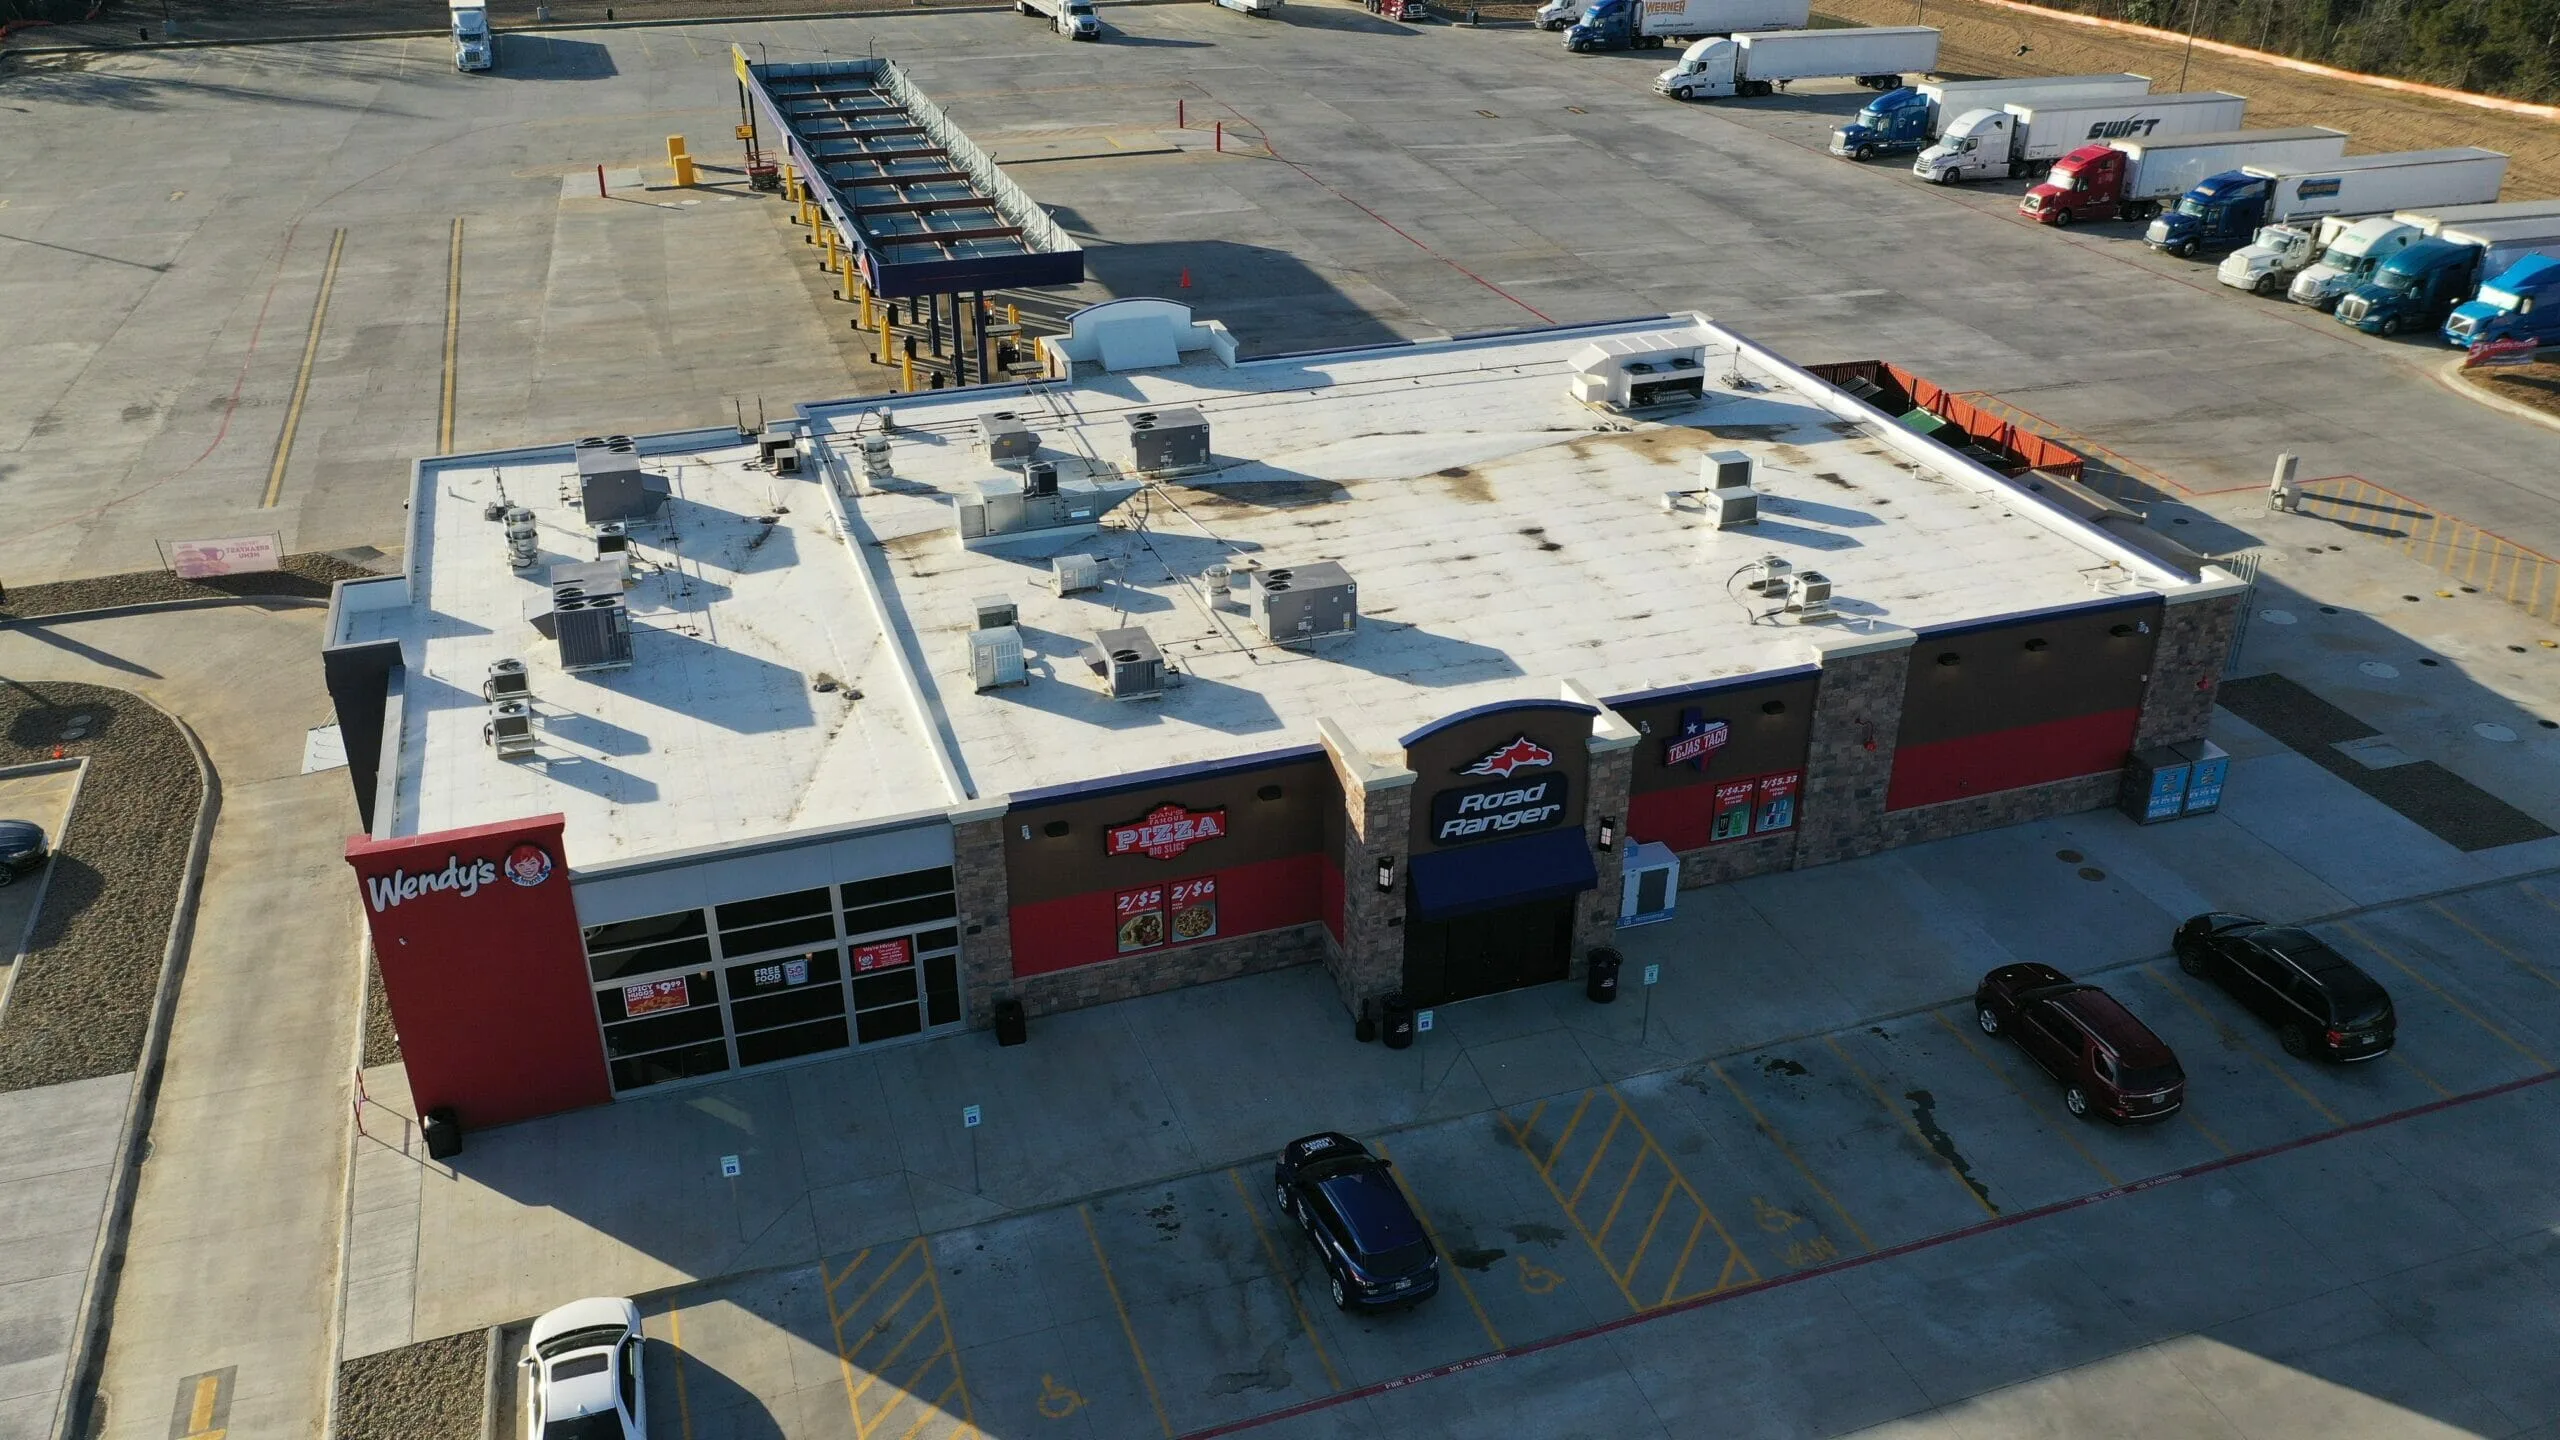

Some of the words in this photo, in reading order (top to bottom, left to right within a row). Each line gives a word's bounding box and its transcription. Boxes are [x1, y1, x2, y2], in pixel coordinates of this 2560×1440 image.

[1645, 0, 1686, 13] WERNER
[2086, 113, 2161, 140] SWIFT
[1669, 738, 1701, 761] TEJAS
[1703, 728, 1728, 748] TACO
[1458, 782, 1547, 814] Road
[1149, 809, 1184, 820] DAN'S
[1149, 815, 1184, 825] FAMOUS
[1440, 804, 1561, 839] Ranger
[1116, 816, 1220, 852] PIZZA
[1165, 842, 1185, 854] SLICE
[367, 855, 496, 913] Wendy's
[1171, 880, 1215, 902] 2/$6
[1117, 890, 1161, 912] 2/$5
[754, 965, 781, 977] FREE
[755, 973, 781, 983] FOOD
[626, 984, 653, 994] SPICY
[1384, 1379, 1406, 1390] FIRE
[1407, 1371, 1436, 1384] LANE
[1449, 1364, 1464, 1373] NO
[1466, 1352, 1507, 1368] PARKING
